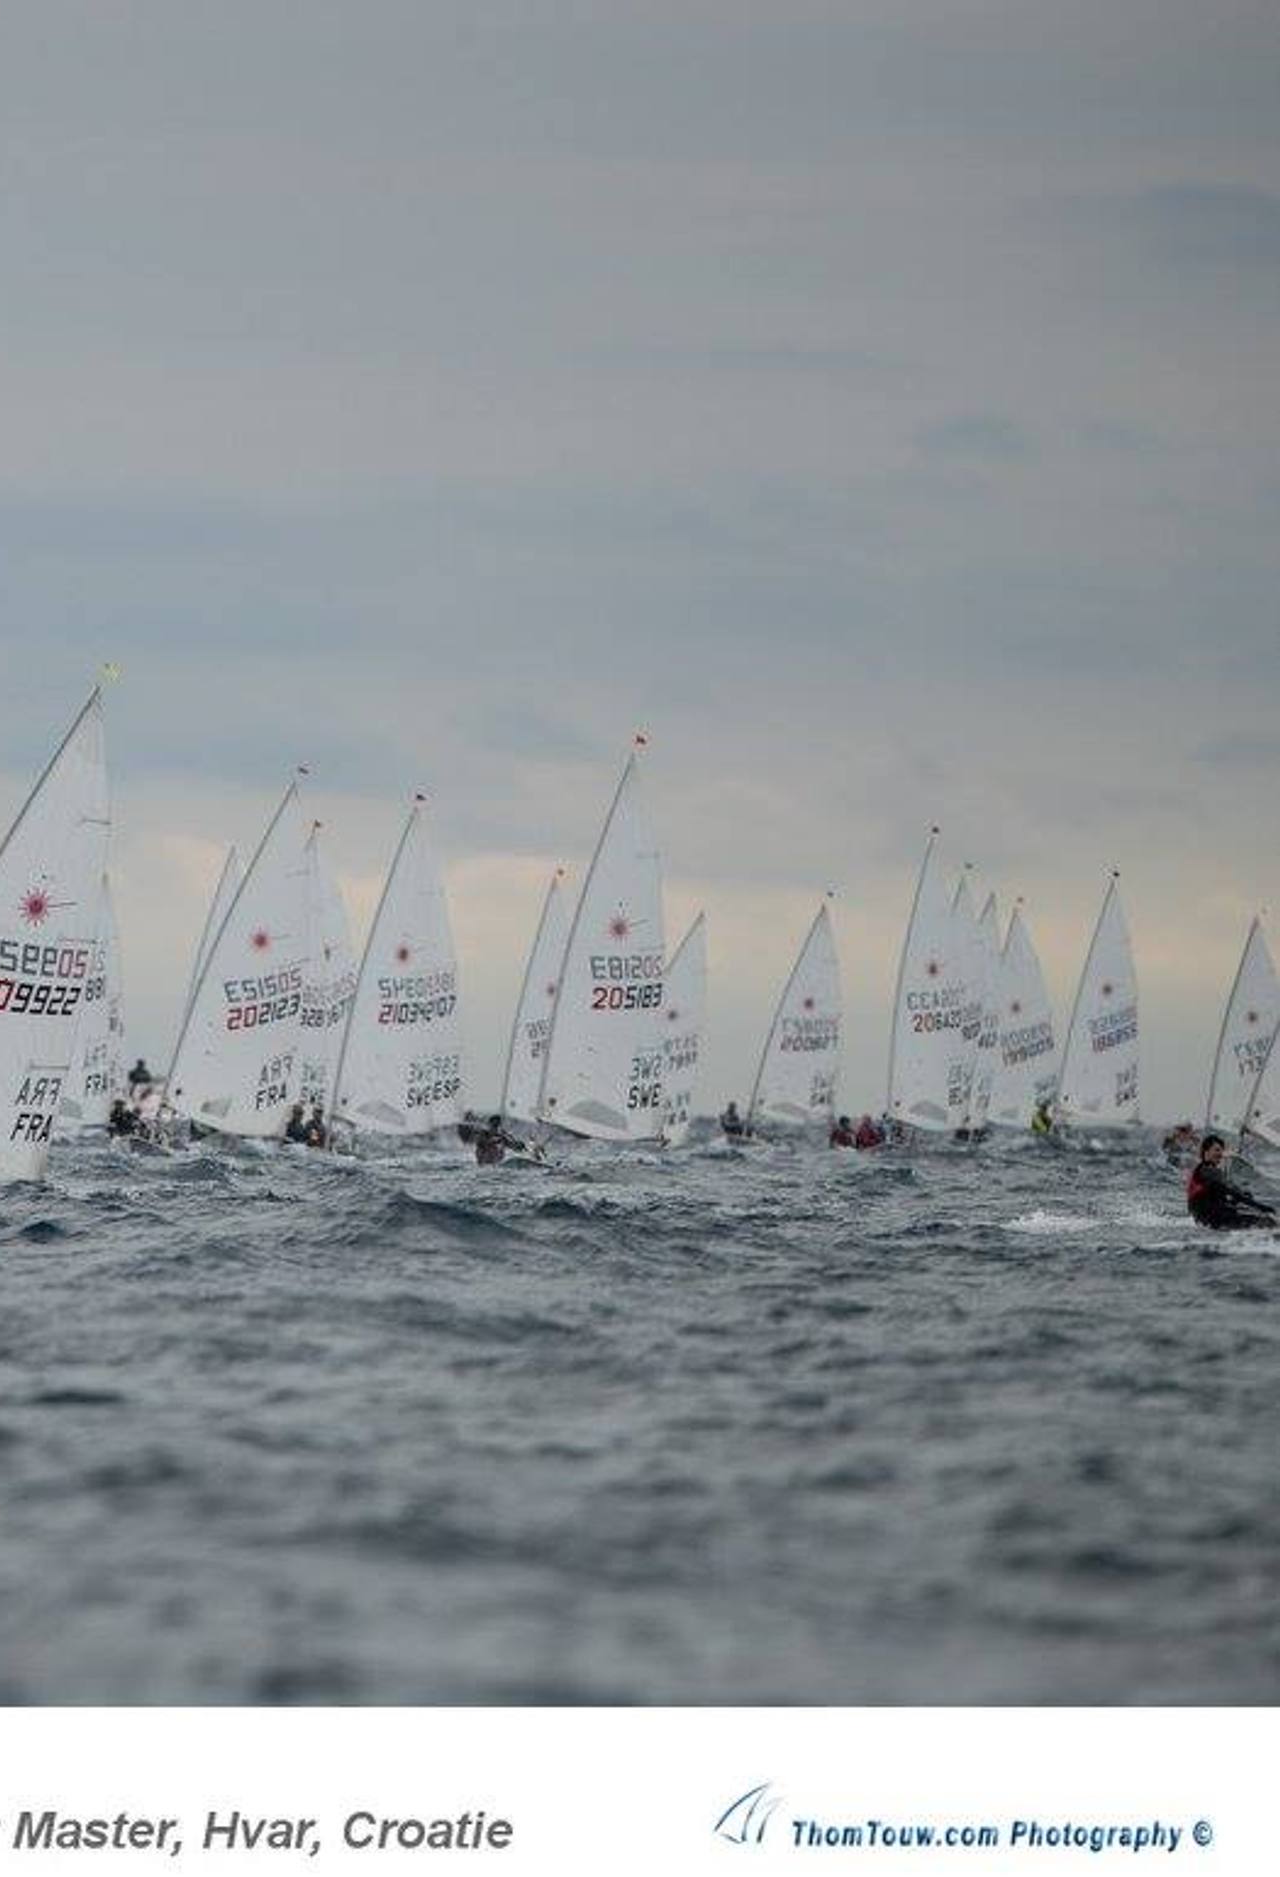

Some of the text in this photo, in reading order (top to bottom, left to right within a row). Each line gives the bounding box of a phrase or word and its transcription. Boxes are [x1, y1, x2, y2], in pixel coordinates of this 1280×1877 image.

[592, 983, 662, 1010] 205183
[226, 994, 300, 1030] 202123
[256, 1083, 287, 1110] FRA
[10, 1113, 52, 1142] FRA
